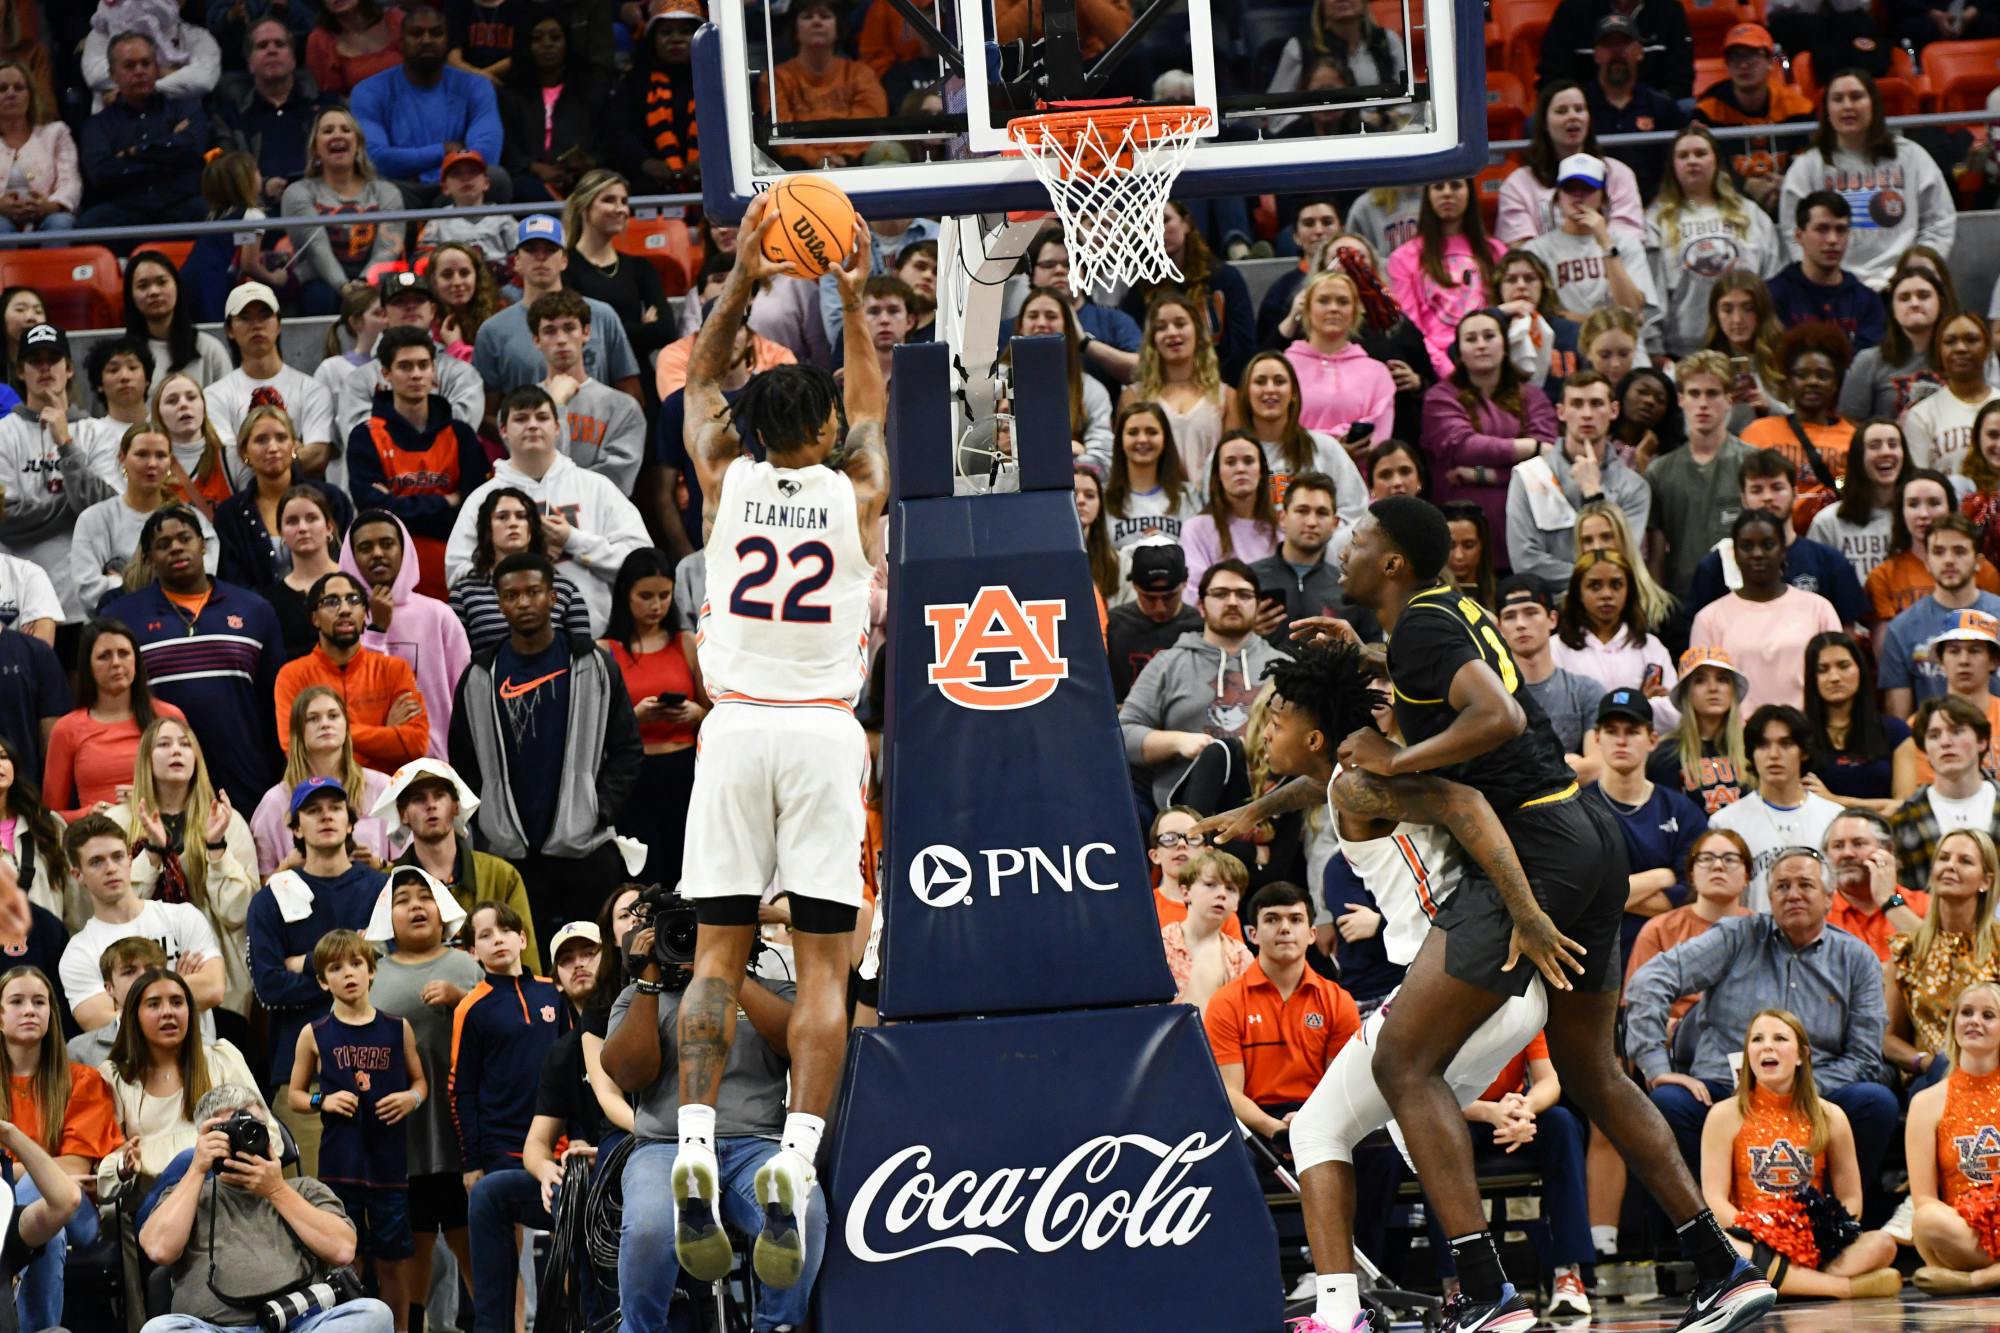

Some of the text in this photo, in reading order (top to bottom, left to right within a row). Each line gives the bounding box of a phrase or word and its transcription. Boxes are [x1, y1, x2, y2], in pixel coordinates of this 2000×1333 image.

[744, 500, 828, 529] FLANIGAN
[729, 534, 835, 624] 22
[978, 842, 1119, 897] PNC
[333, 1045, 391, 1070] TIGERS
[844, 1129, 1232, 1263] Coca-Cola
